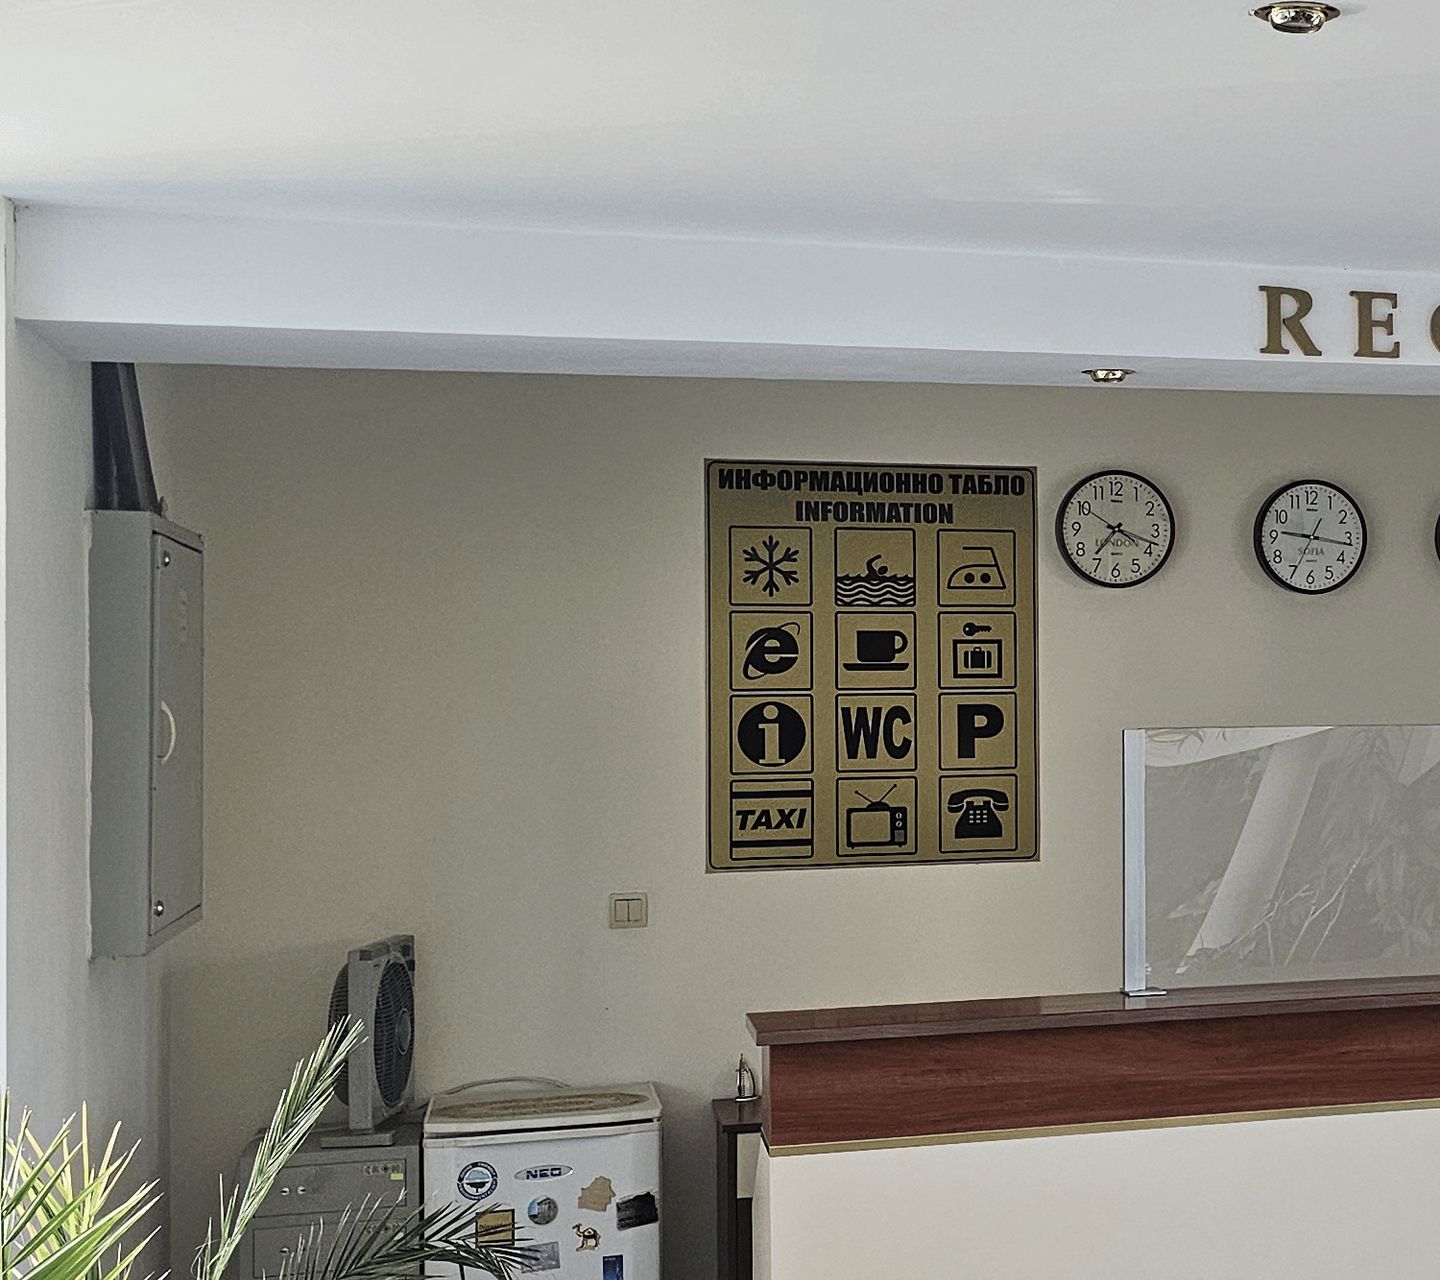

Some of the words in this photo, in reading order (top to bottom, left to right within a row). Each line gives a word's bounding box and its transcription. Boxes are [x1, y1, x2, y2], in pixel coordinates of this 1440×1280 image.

[718, 468, 944, 496] ИНФОРМАЦИОННО
[949, 473, 1026, 496] ТАБЛО
[1109, 481, 1123, 497] 12
[1092, 485, 1104, 501] 11
[1304, 490, 1318, 505] 12
[1077, 500, 1091, 516] 10
[1145, 501, 1155, 516] 2
[1289, 494, 1300, 509] 11
[795, 500, 954, 524] INFORMATION
[1274, 509, 1288, 525] 10
[1339, 509, 1348, 525] 2
[1071, 521, 1082, 537] 9
[1151, 523, 1160, 538] 3
[1269, 529, 1279, 545] 9
[1344, 531, 1353, 546] 3
[1076, 542, 1085, 557] 8
[1144, 542, 1153, 557] 4
[1272, 549, 1282, 564] 8
[1336, 550, 1345, 564] 4
[1092, 558, 1102, 573] 7
[1111, 562, 1121, 578] 6
[1131, 558, 1141, 574] 5
[1288, 564, 1298, 580] 7
[1324, 565, 1334, 580] 5
[1306, 569, 1315, 584] 6
[841, 705, 912, 760] WC
[957, 704, 1005, 759] P
[735, 808, 807, 831] TAXI
[526, 1167, 562, 1180] NEO
